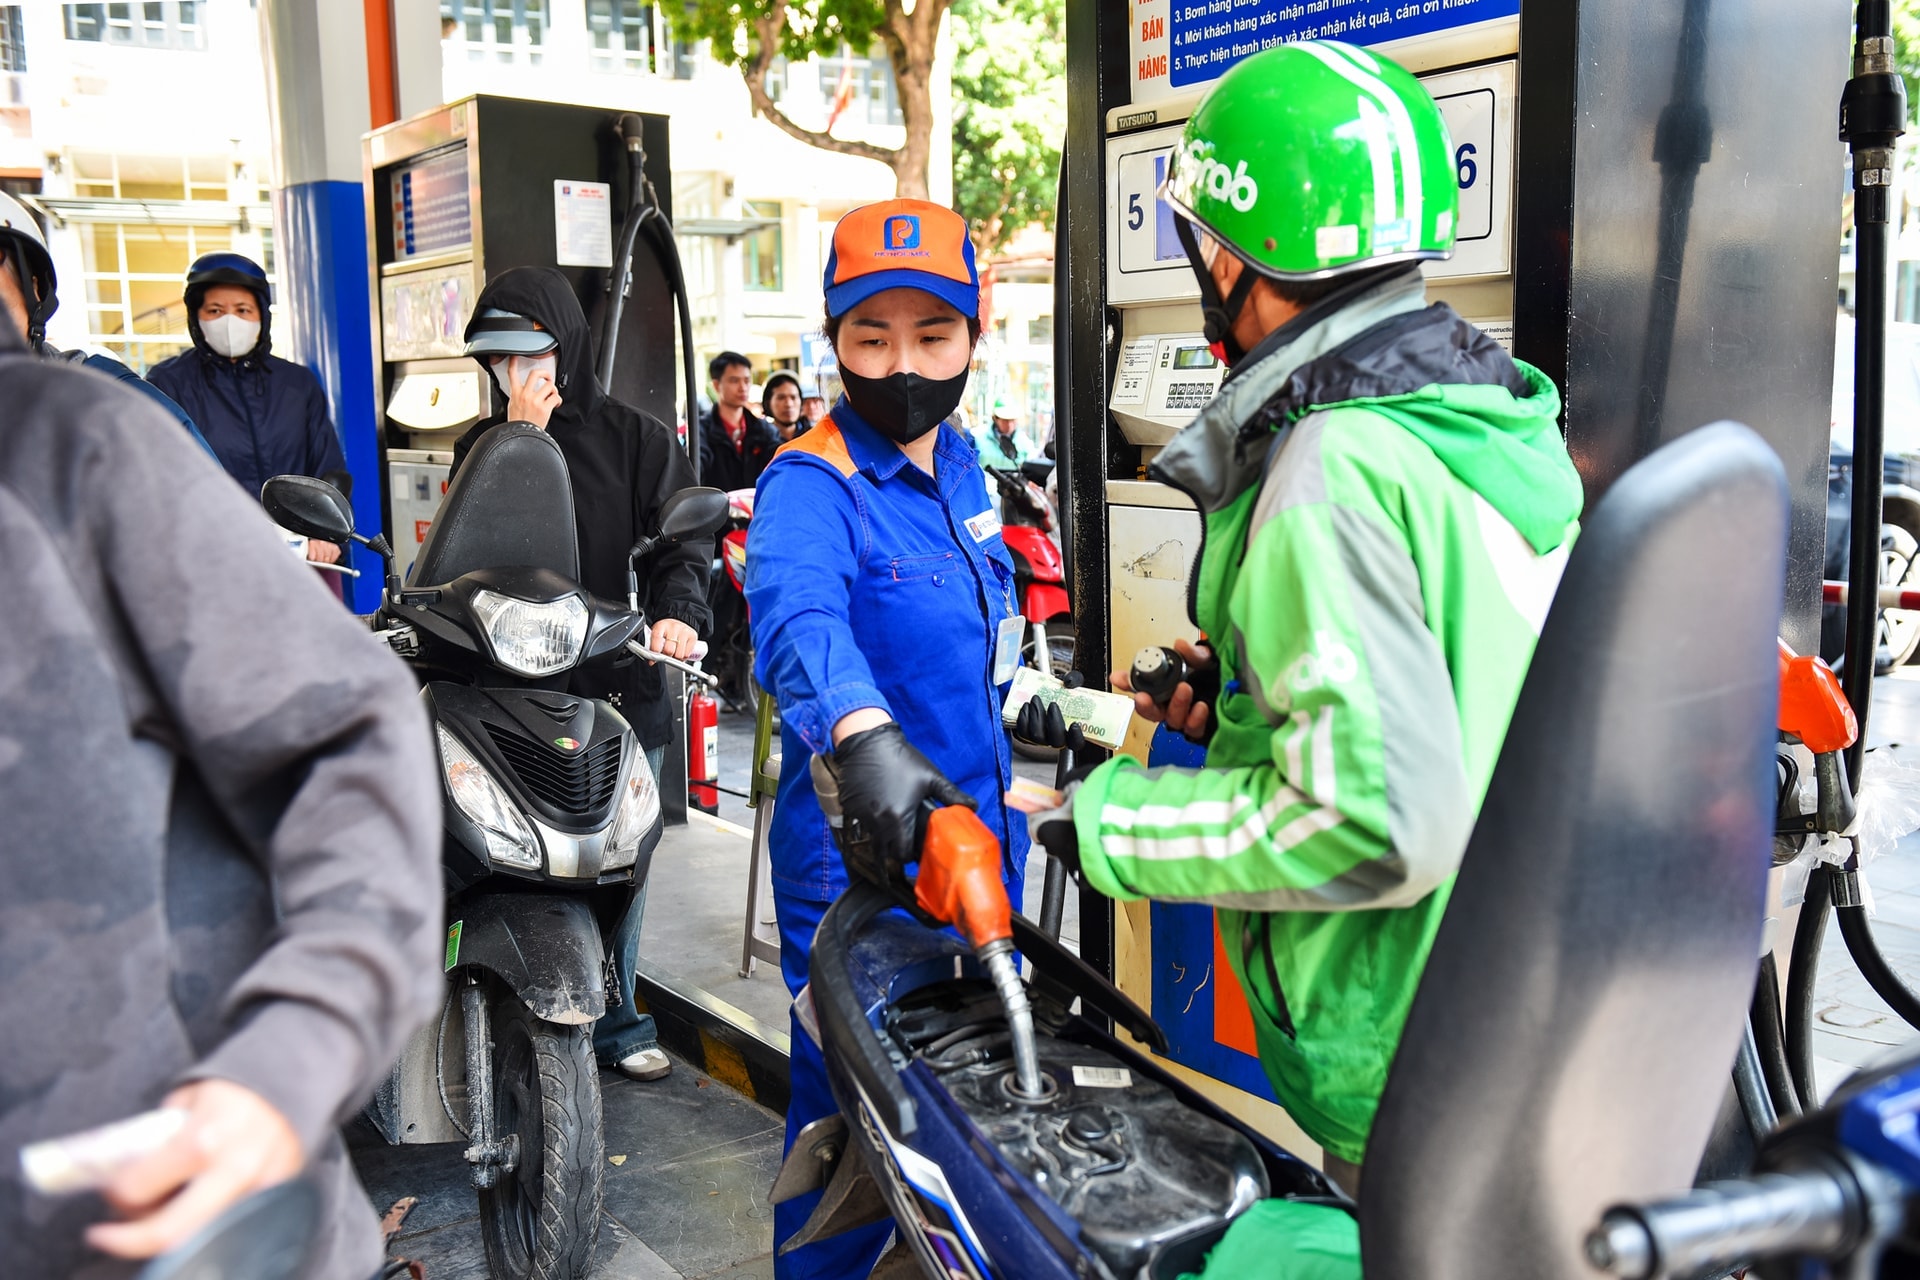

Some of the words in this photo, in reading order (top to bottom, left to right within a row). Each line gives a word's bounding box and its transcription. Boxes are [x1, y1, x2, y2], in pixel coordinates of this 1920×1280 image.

[1142, 15, 1164, 42] BÁN
[1174, 10, 1183, 23] 3.
[1185, 6, 1206, 21] Bơm
[1174, 34, 1183, 47] 4.
[1185, 28, 1202, 45] Mời
[1204, 22, 1232, 40] khách
[1234, 17, 1258, 31] hàng
[1260, 10, 1277, 26] xác
[1280, 3, 1304, 21] nhận
[1174, 57, 1183, 70] 5.
[1185, 53, 1208, 69] Thực
[1210, 49, 1230, 64] hiện
[1232, 40, 1259, 57] thanh
[1261, 34, 1283, 51] toán
[1286, 29, 1297, 44] và
[1300, 25, 1318, 42] xác
[1320, 19, 1347, 37] nhận
[1349, 11, 1367, 30] kết
[1368, 7, 1393, 29] quả,
[1395, 3, 1420, 20] cám
[1423, 0, 1440, 14] ơn
[1138, 55, 1167, 81] HÀNG
[1118, 112, 1155, 129] TATSUNO
[1456, 142, 1477, 189] 6
[1128, 193, 1144, 231] 5
